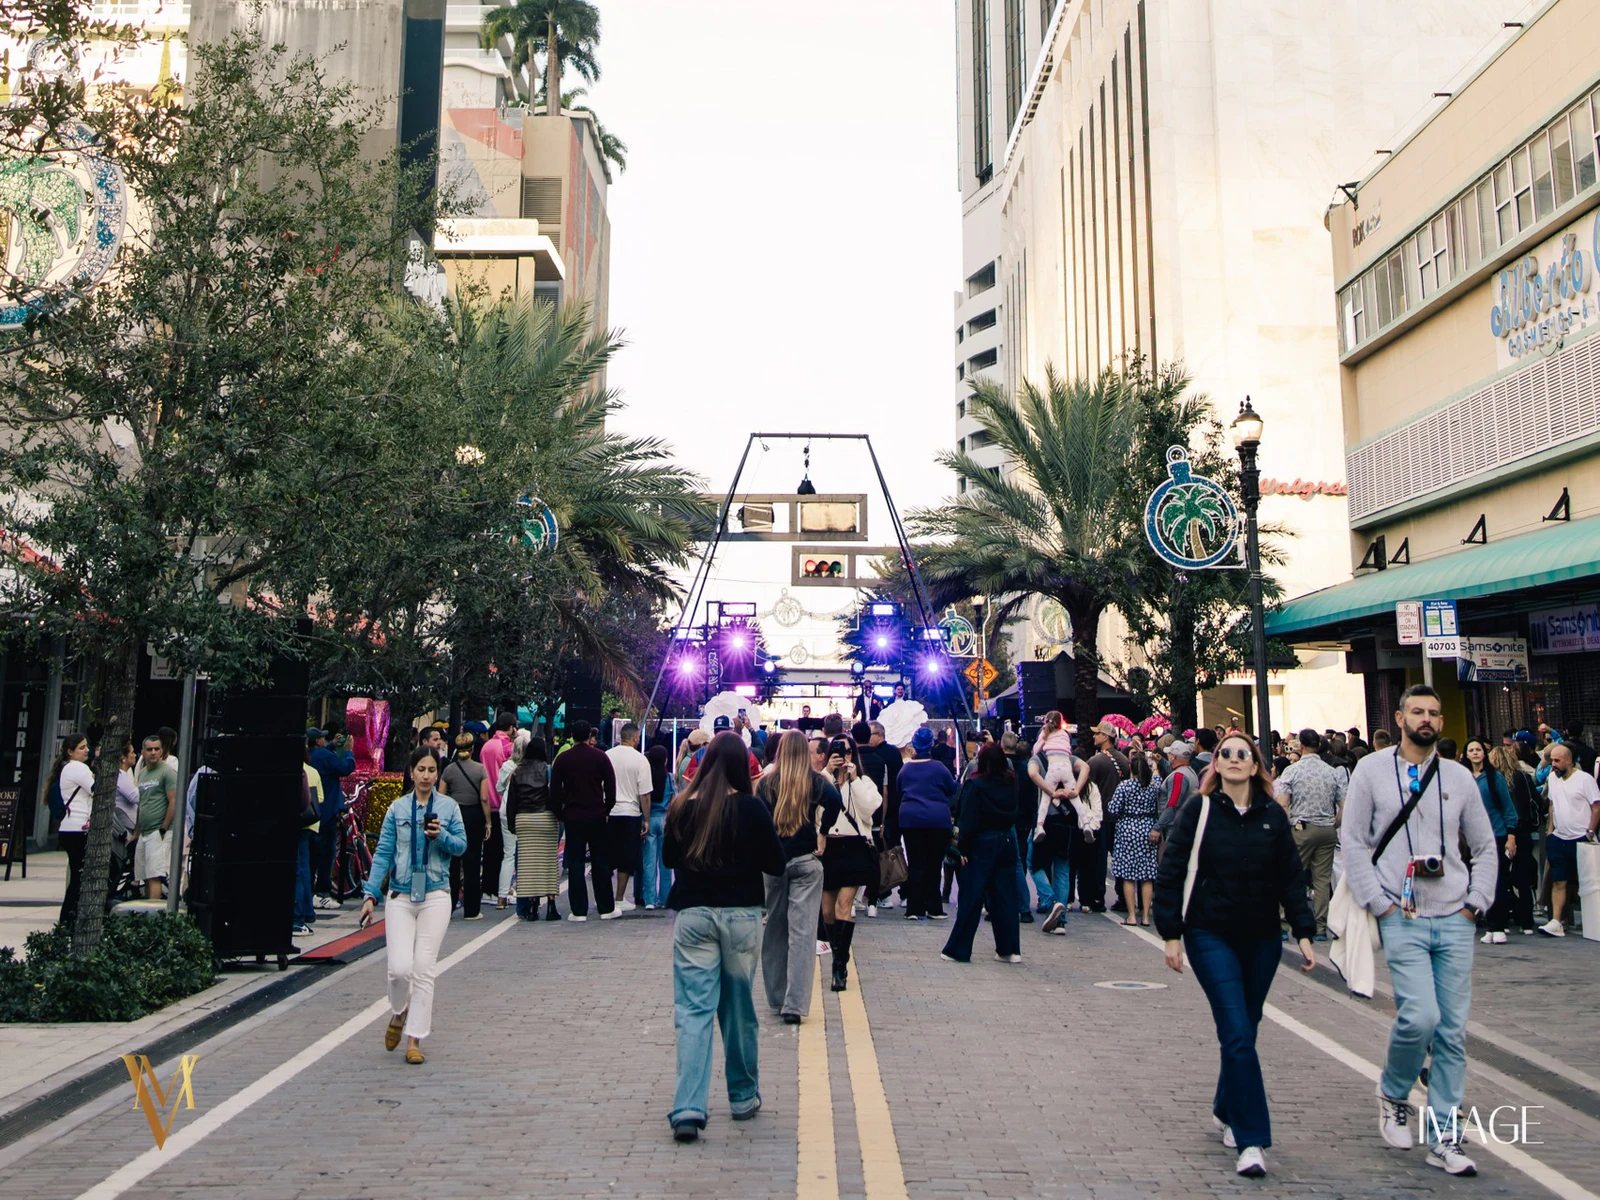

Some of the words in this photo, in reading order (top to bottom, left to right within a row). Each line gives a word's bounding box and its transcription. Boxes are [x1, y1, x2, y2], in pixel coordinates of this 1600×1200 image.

[1490, 233, 1588, 338] Alberto
[1508, 306, 1574, 357] COSMETICS
[1428, 642, 1456, 651] 40703
[1460, 641, 1525, 653] Samsonite
